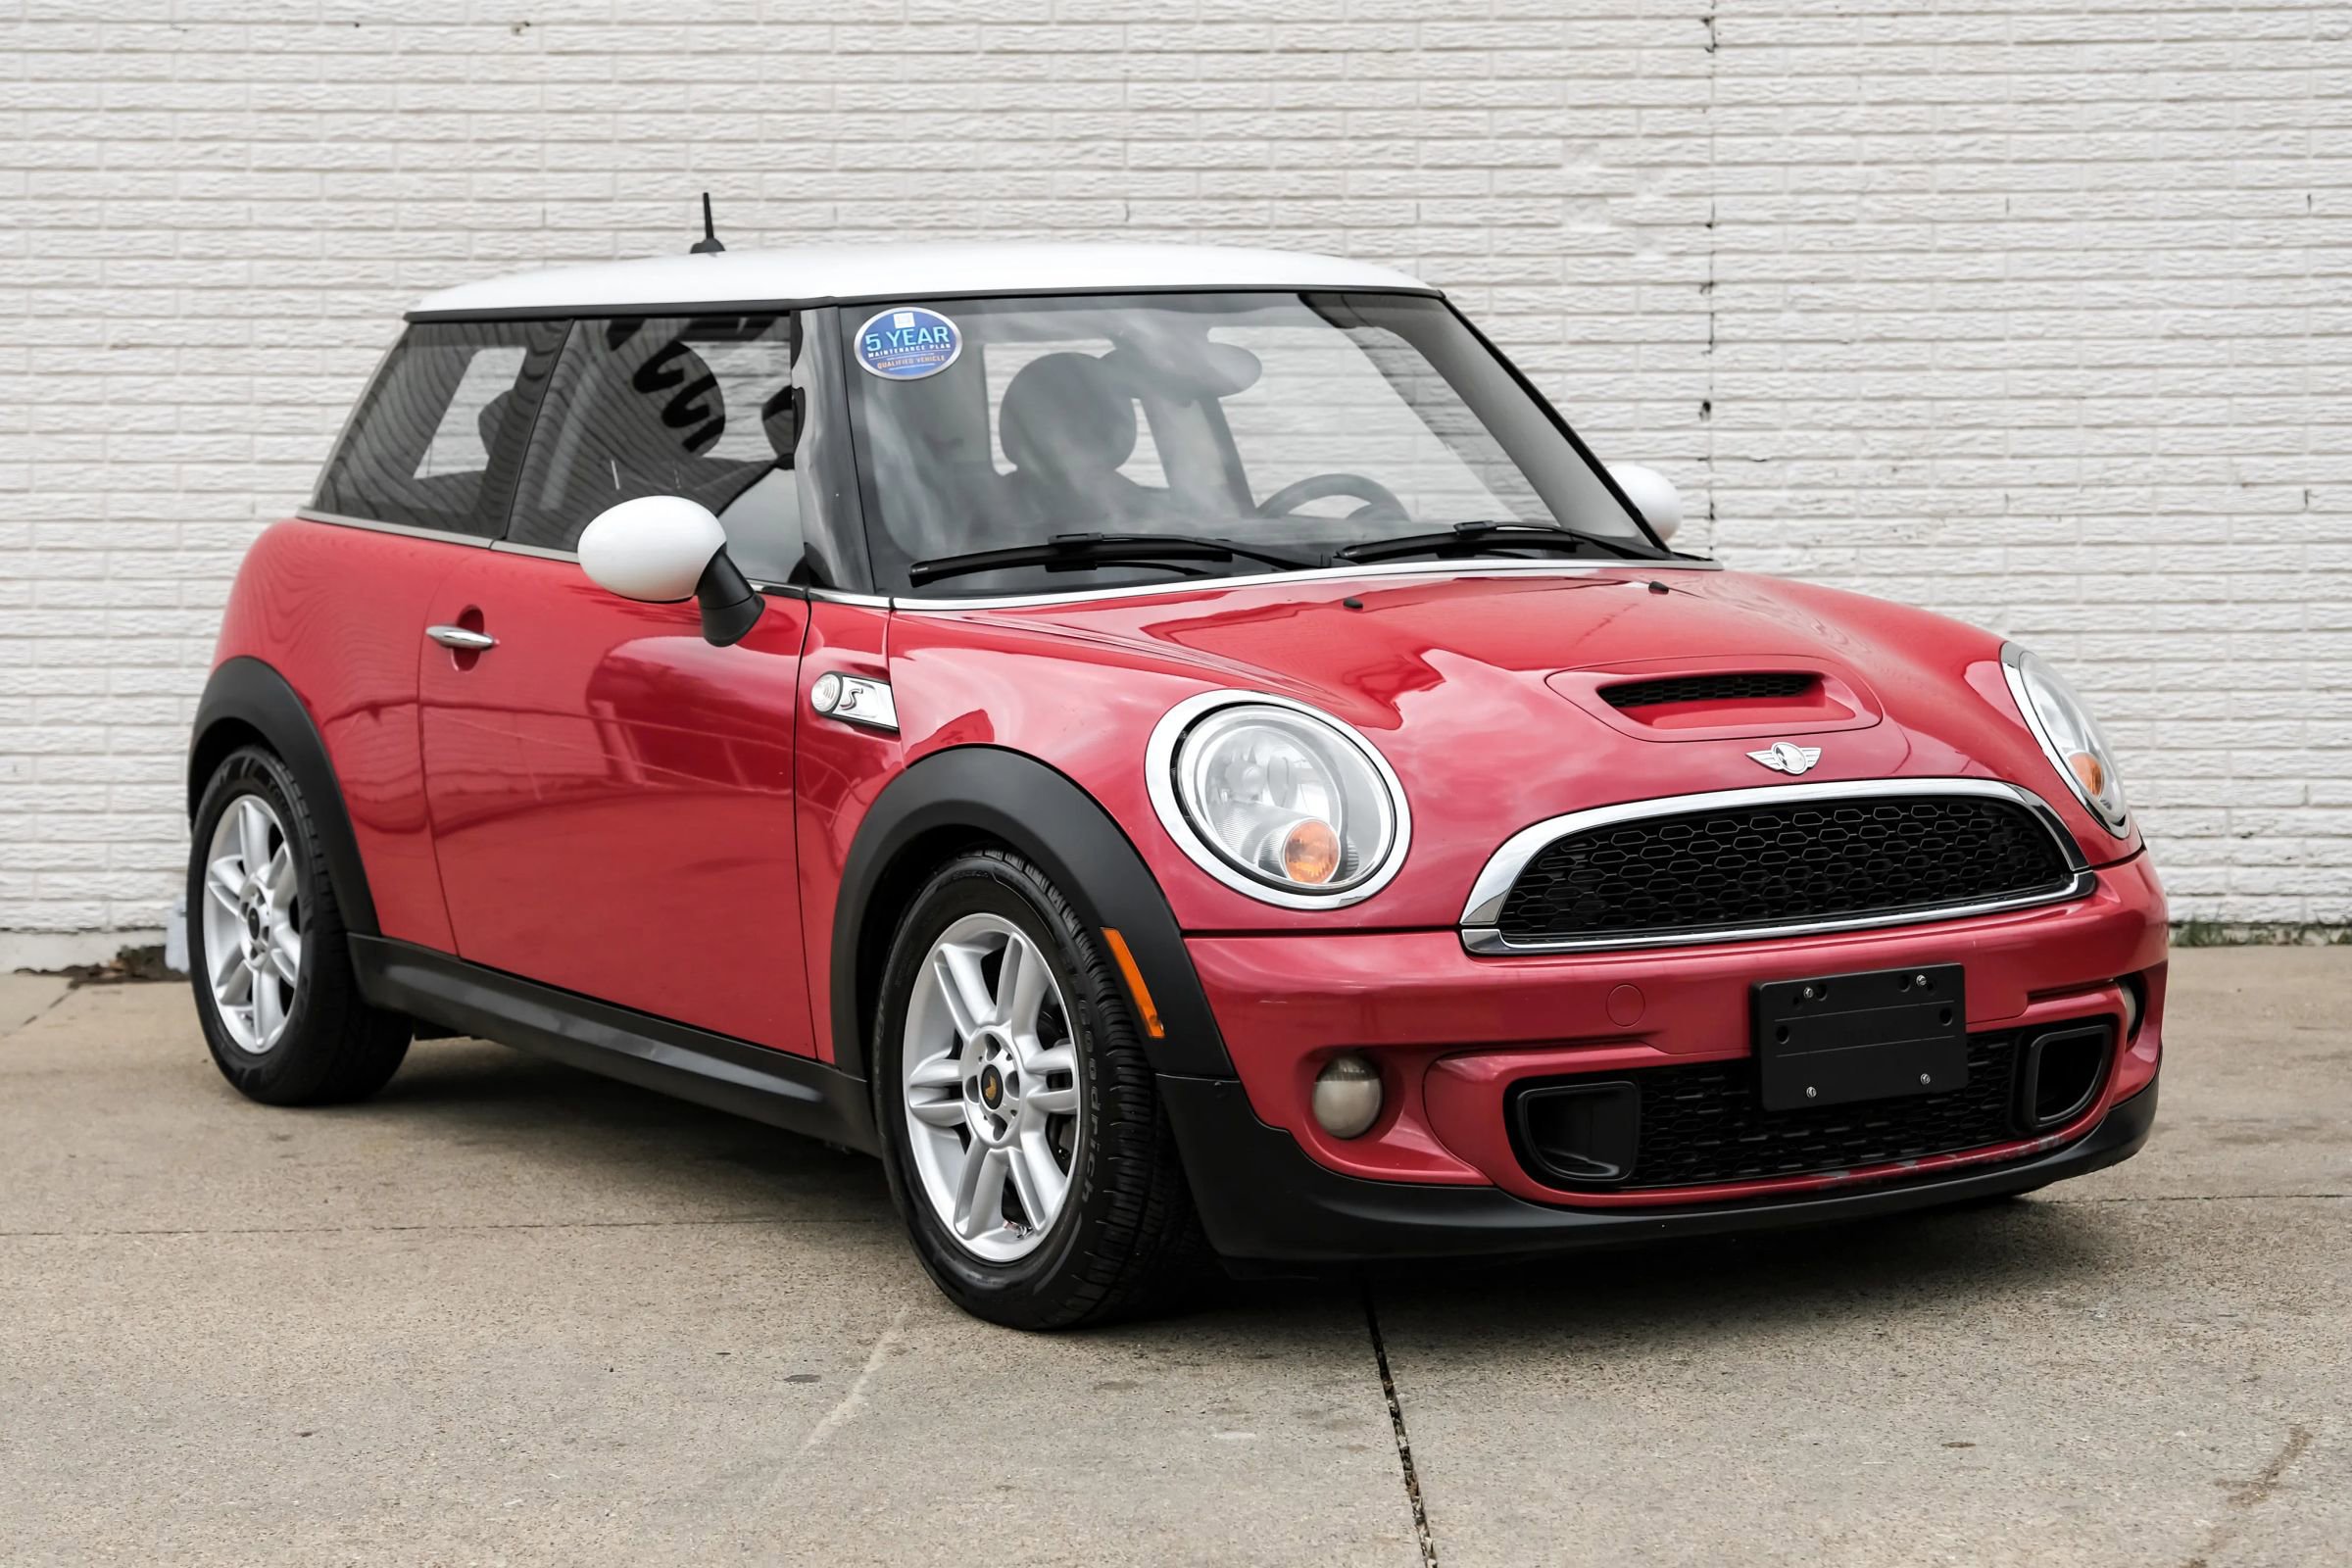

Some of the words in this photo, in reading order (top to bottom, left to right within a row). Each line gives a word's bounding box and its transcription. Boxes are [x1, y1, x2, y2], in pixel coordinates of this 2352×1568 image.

[865, 333, 882, 352] 5
[886, 326, 950, 348] YEAR
[867, 345, 926, 359] MAINTENANCE
[877, 357, 914, 369] QUALIFIED
[916, 355, 946, 364] VEHICLE
[840, 688, 864, 710] S
